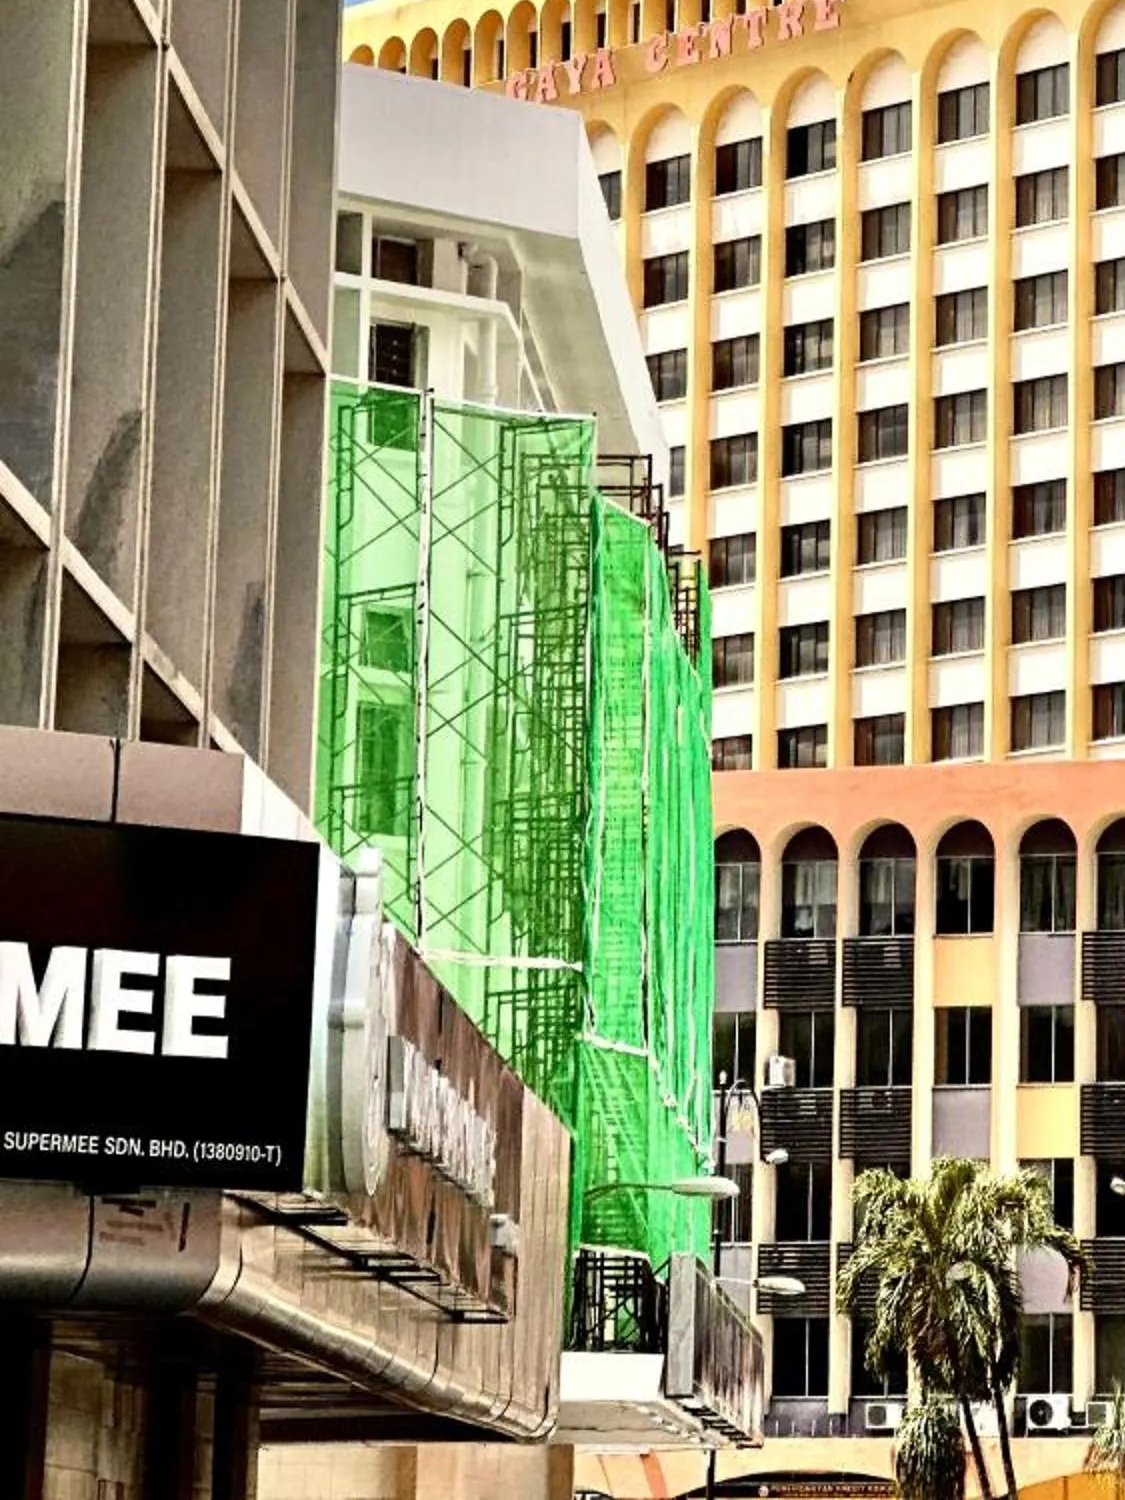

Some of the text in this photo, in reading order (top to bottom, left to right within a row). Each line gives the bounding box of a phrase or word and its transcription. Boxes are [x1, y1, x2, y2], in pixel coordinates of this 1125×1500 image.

[505, 48, 617, 101] GAYA
[0, 940, 232, 1059] MEE
[3, 1131, 282, 1166] SUPERMEE SDN. BHD. (1380910-T)
